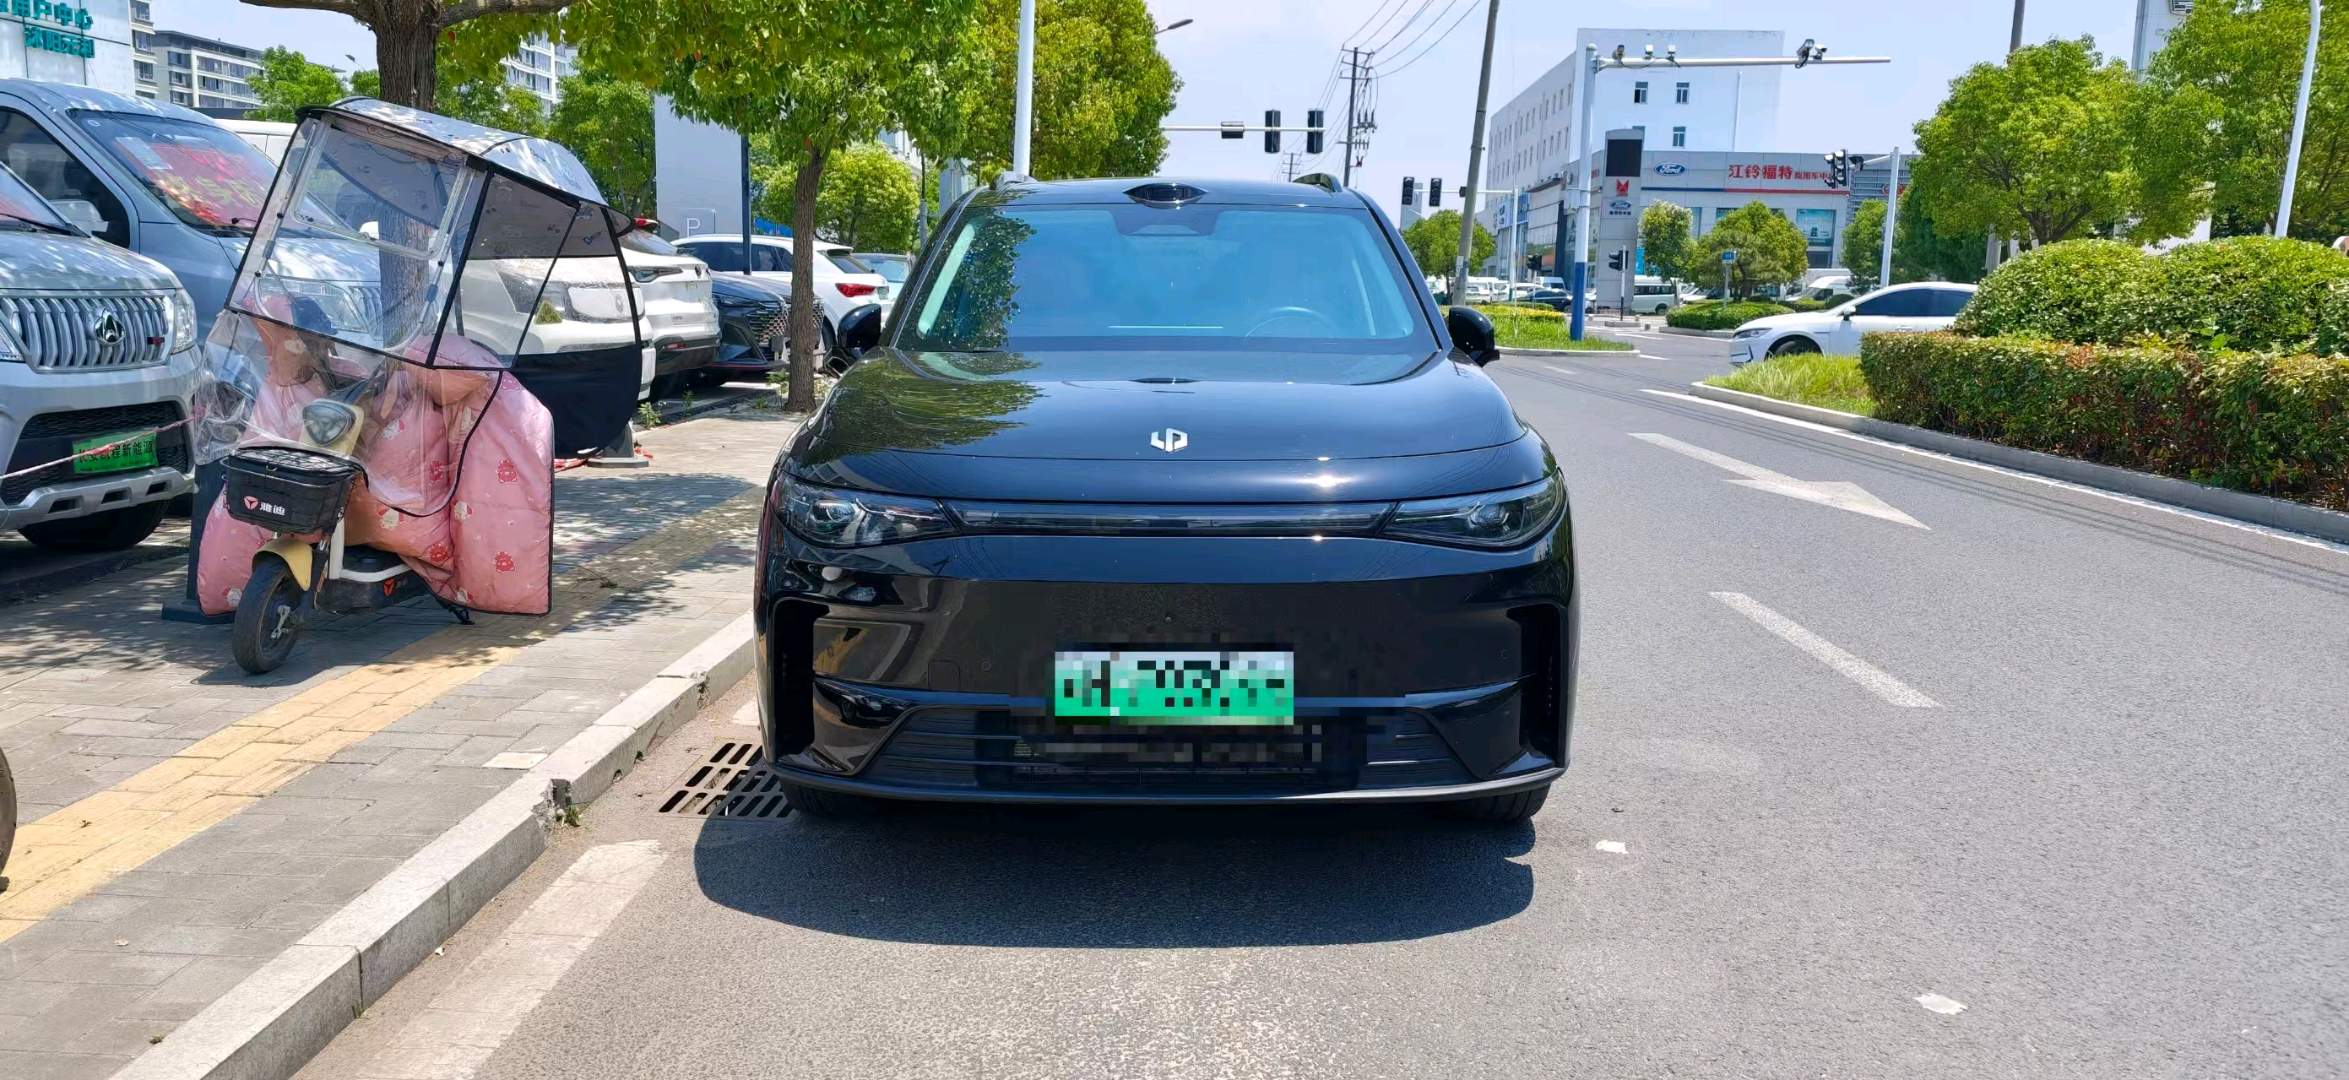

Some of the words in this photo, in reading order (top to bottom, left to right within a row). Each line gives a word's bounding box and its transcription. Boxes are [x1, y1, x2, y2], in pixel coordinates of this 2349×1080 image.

[1657, 164, 1684, 175] Ford
[1728, 164, 1793, 180] 江铃福特
[686, 217, 701, 237] P
